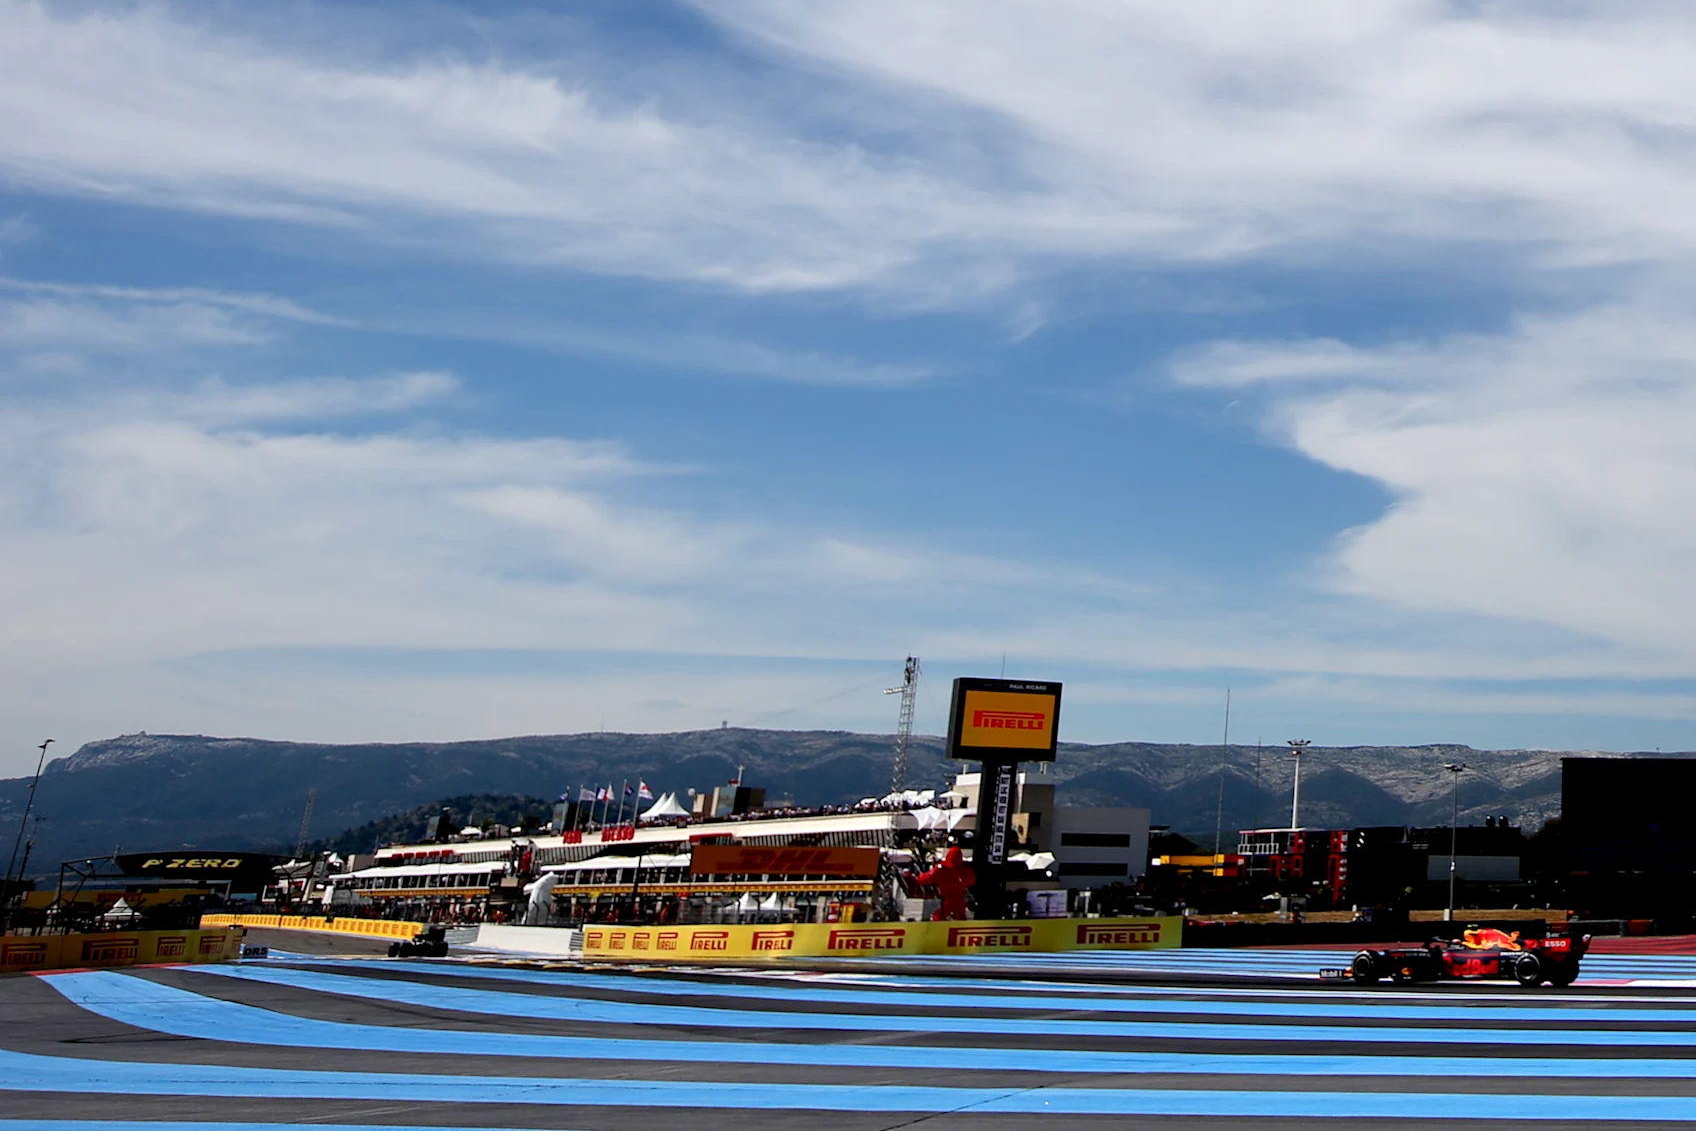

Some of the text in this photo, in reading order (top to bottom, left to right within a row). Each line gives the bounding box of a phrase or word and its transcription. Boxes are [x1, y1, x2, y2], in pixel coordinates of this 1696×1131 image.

[973, 710, 1045, 730] PIRELLI
[166, 859, 242, 868] ZERO
[736, 849, 838, 872] DHL
[690, 932, 728, 950] PIRELLI
[751, 930, 794, 950] PIRELLI
[828, 929, 905, 950] PIRELLI
[947, 926, 1032, 947] PIRELLI
[1076, 924, 1161, 944] PIRELLI
[1545, 940, 1566, 948] ESSO
[1, 943, 48, 966] PIRELLI
[156, 936, 186, 957] PIRELLI
[244, 947, 268, 956] DRS
[1320, 970, 1338, 978] Mobil
